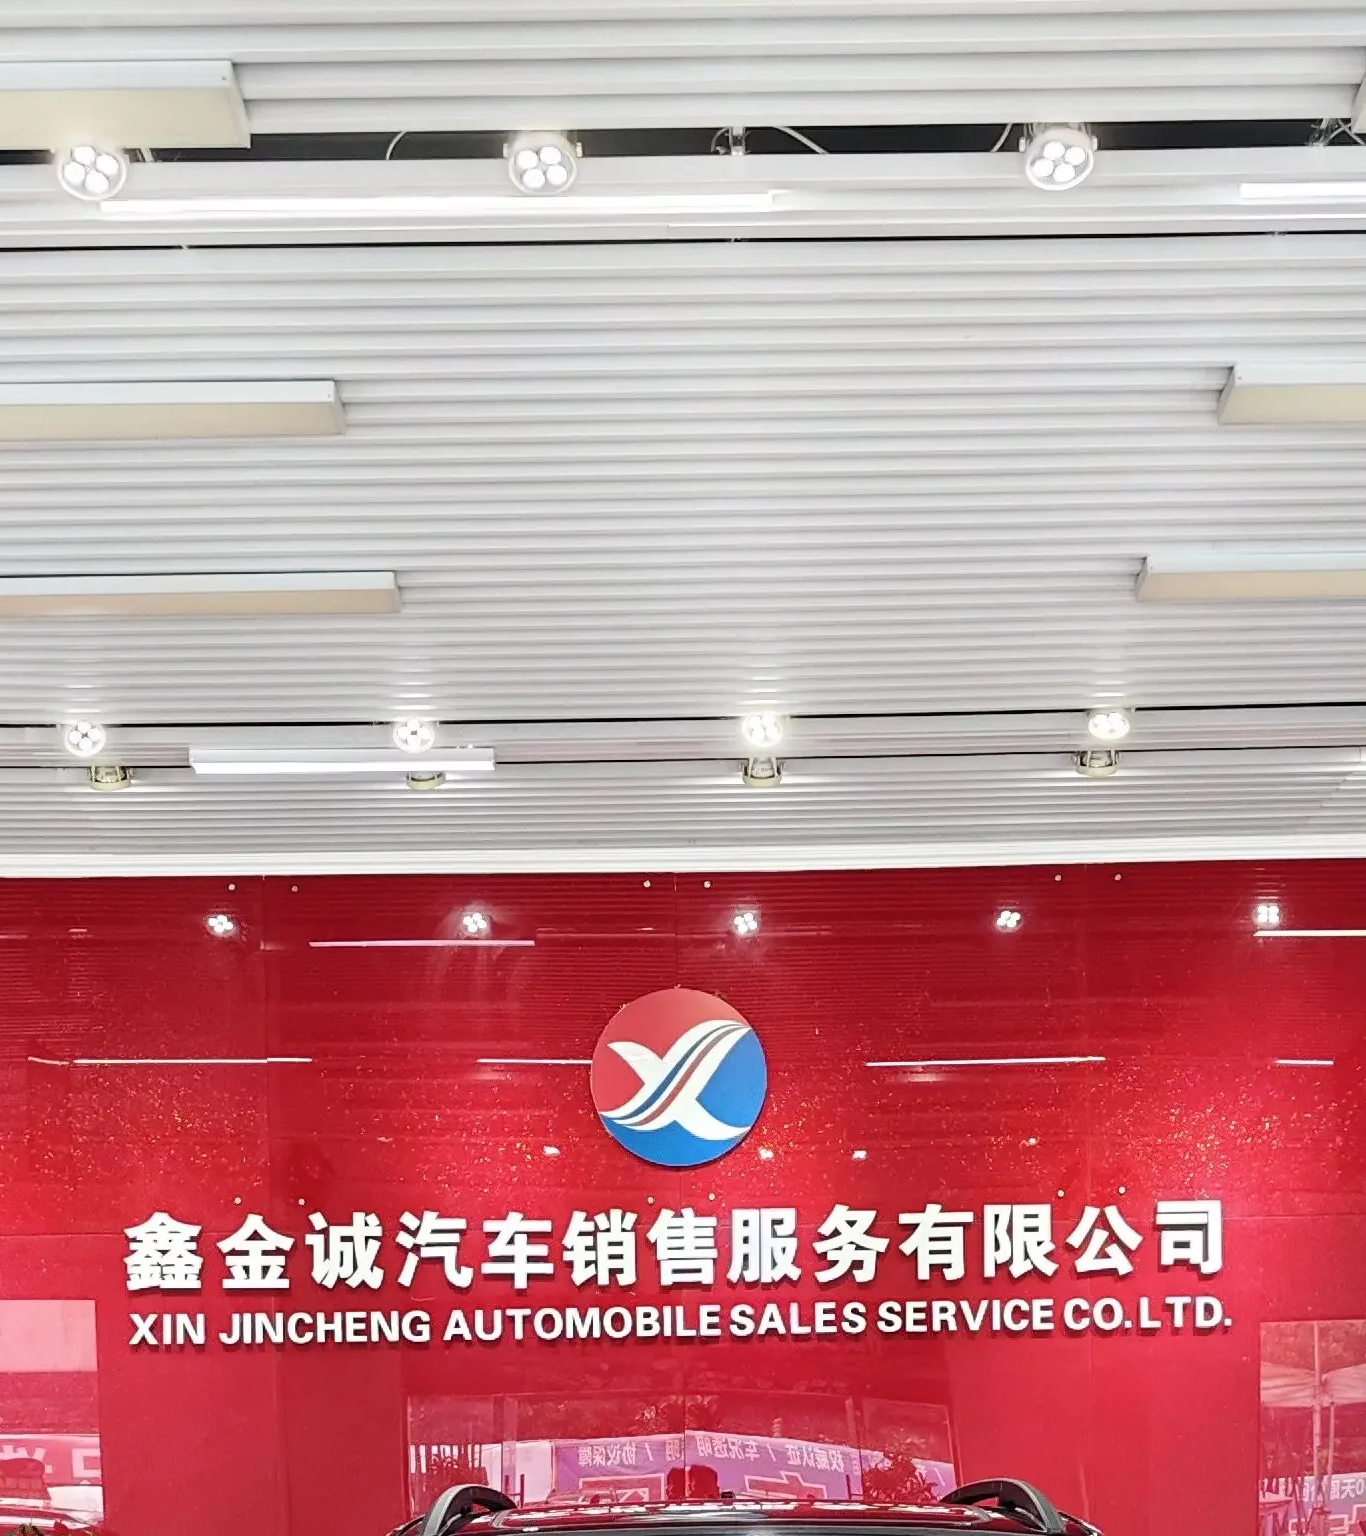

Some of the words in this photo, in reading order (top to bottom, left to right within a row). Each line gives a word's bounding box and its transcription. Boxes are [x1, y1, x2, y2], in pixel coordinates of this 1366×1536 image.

[123, 1199, 1225, 1293] 鑫金诚汽车销售服务有限公司
[129, 1312, 206, 1346] XIN
[218, 1309, 432, 1345] JINCHENG
[443, 1303, 722, 1343] AUTOMOBILE
[729, 1302, 867, 1337] SALES
[877, 1299, 1055, 1334] SERVICE
